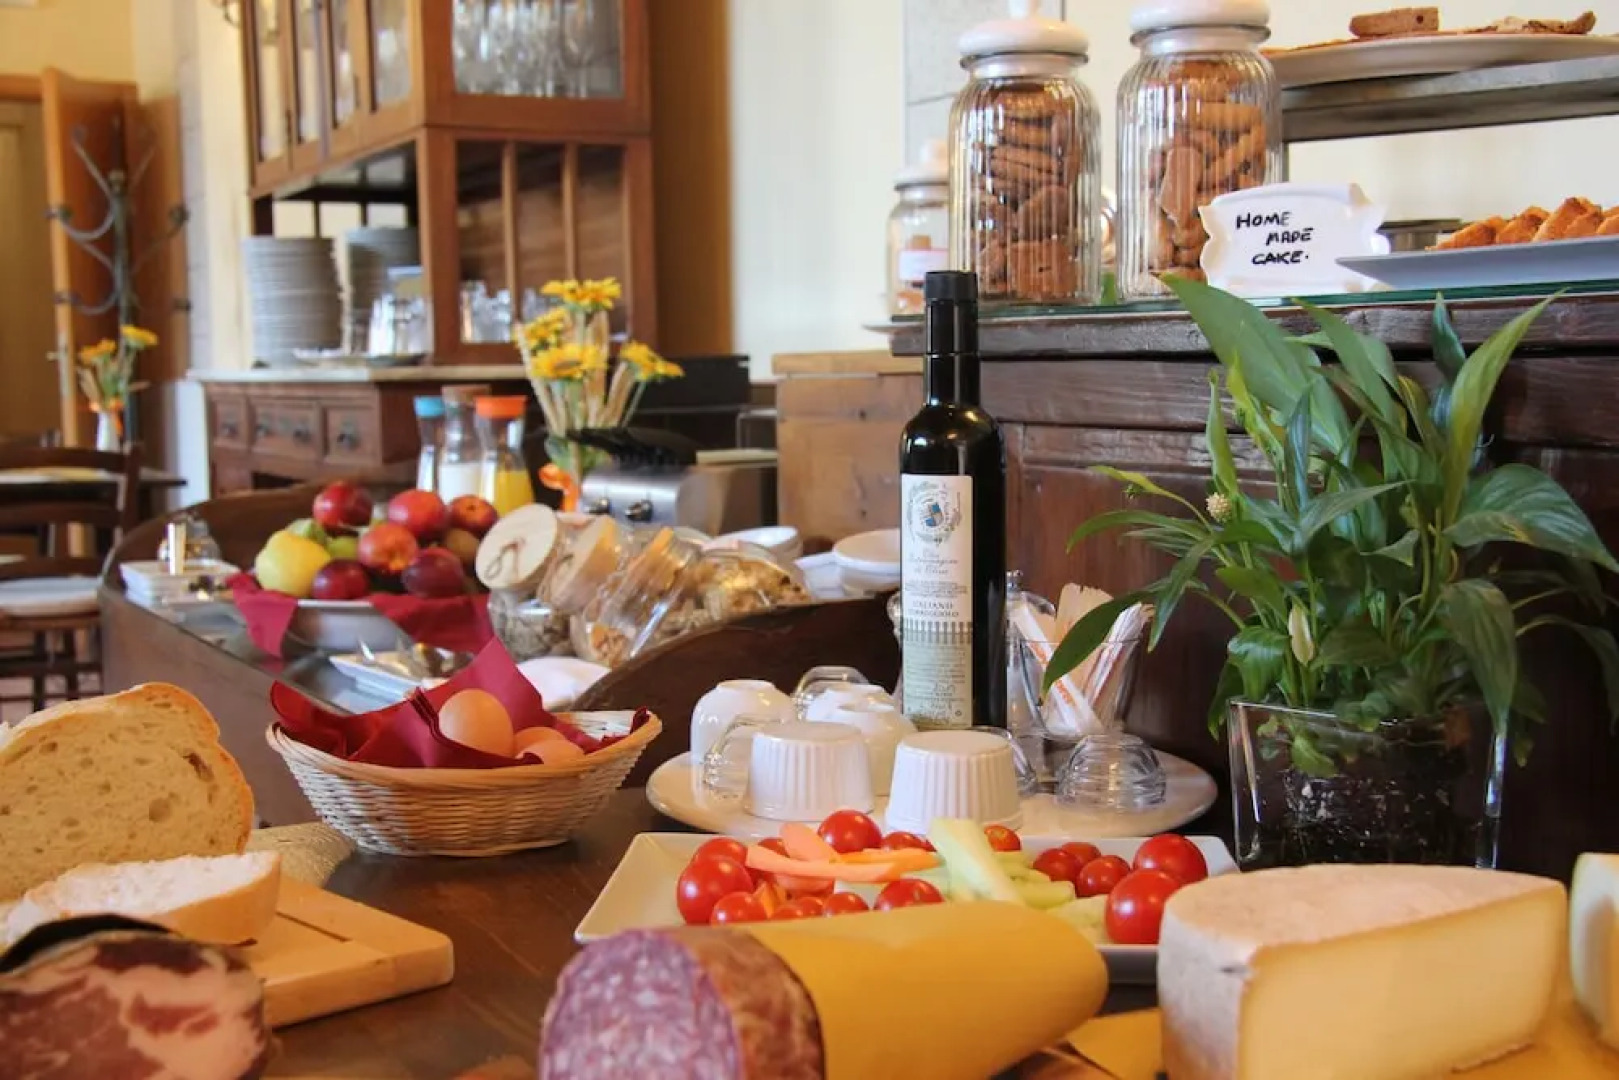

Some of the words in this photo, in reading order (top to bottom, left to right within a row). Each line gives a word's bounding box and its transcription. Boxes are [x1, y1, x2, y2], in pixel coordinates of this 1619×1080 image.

[1236, 211, 1292, 230] HOME
[1265, 227, 1315, 246] MADE
[1251, 250, 1309, 265] CAKE.
